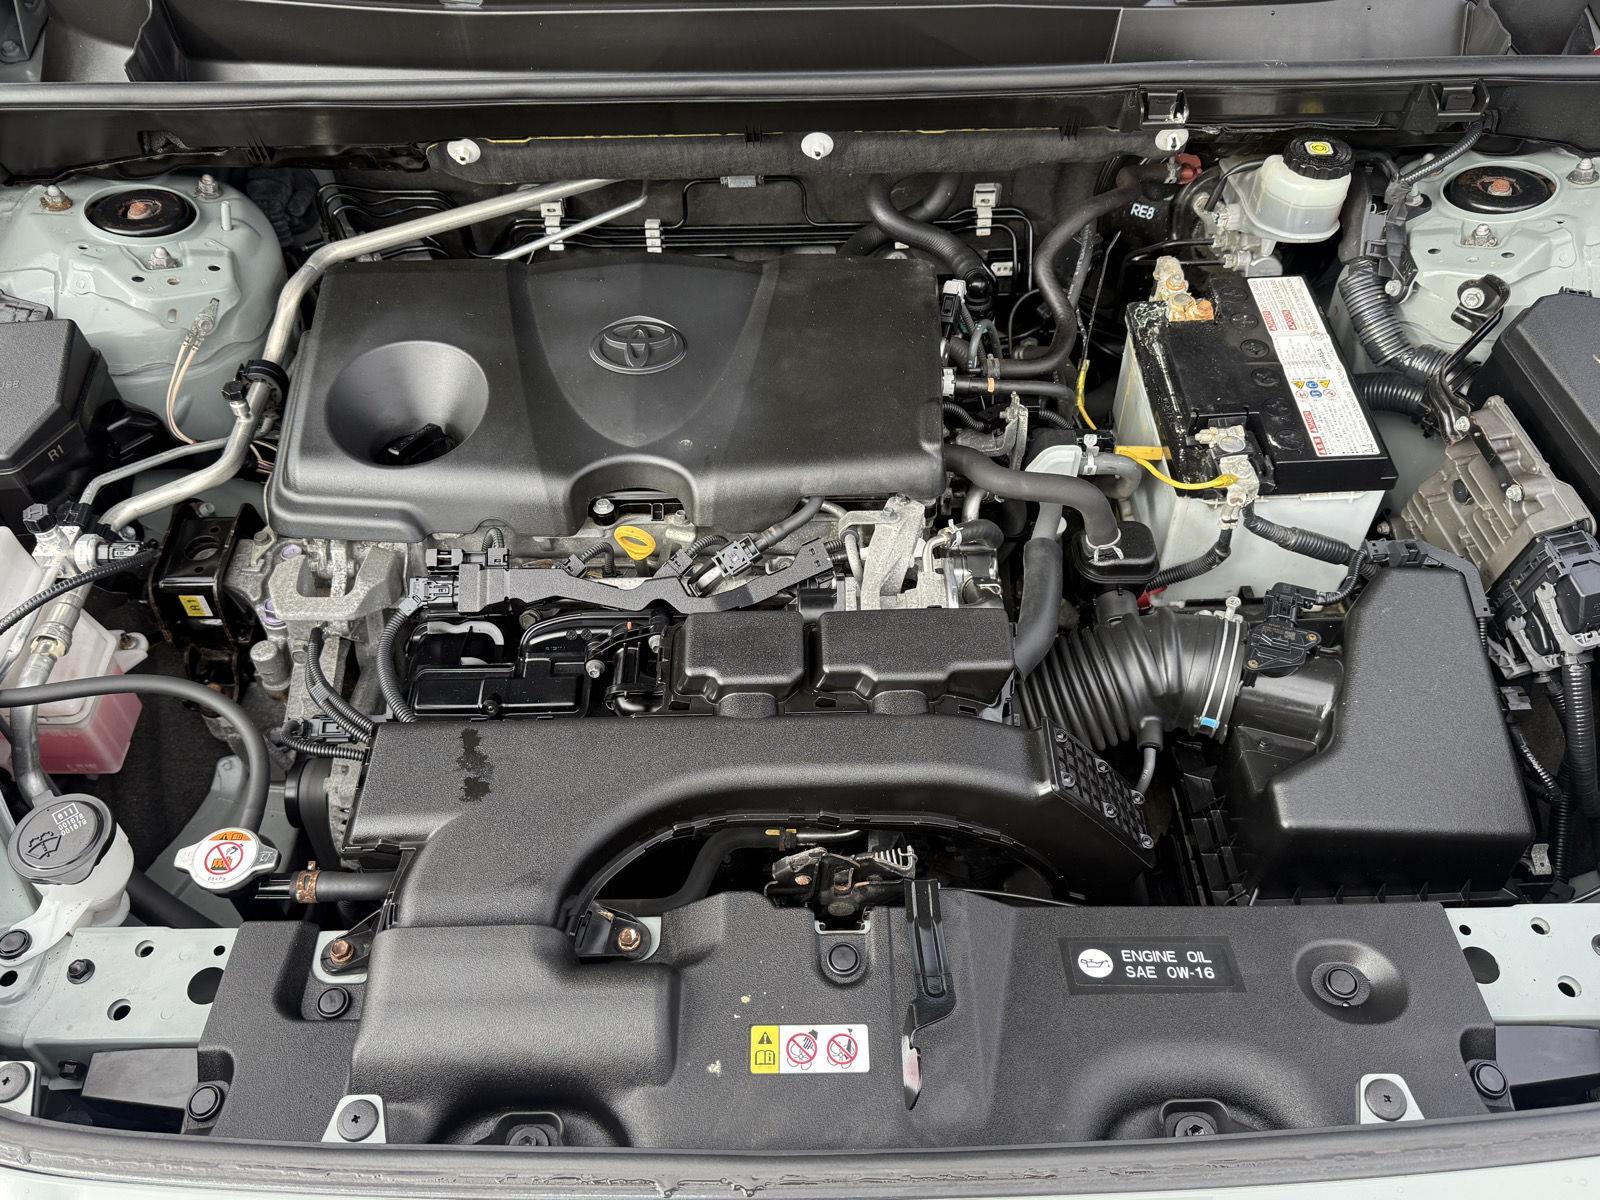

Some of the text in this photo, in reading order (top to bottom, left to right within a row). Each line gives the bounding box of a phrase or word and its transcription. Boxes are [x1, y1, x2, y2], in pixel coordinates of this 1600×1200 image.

[1130, 203, 1155, 220] RE8
[48, 444, 64, 462] R1
[1121, 950, 1212, 963] ENGINE OIL
[1125, 966, 1215, 979] SAE 0W-16
